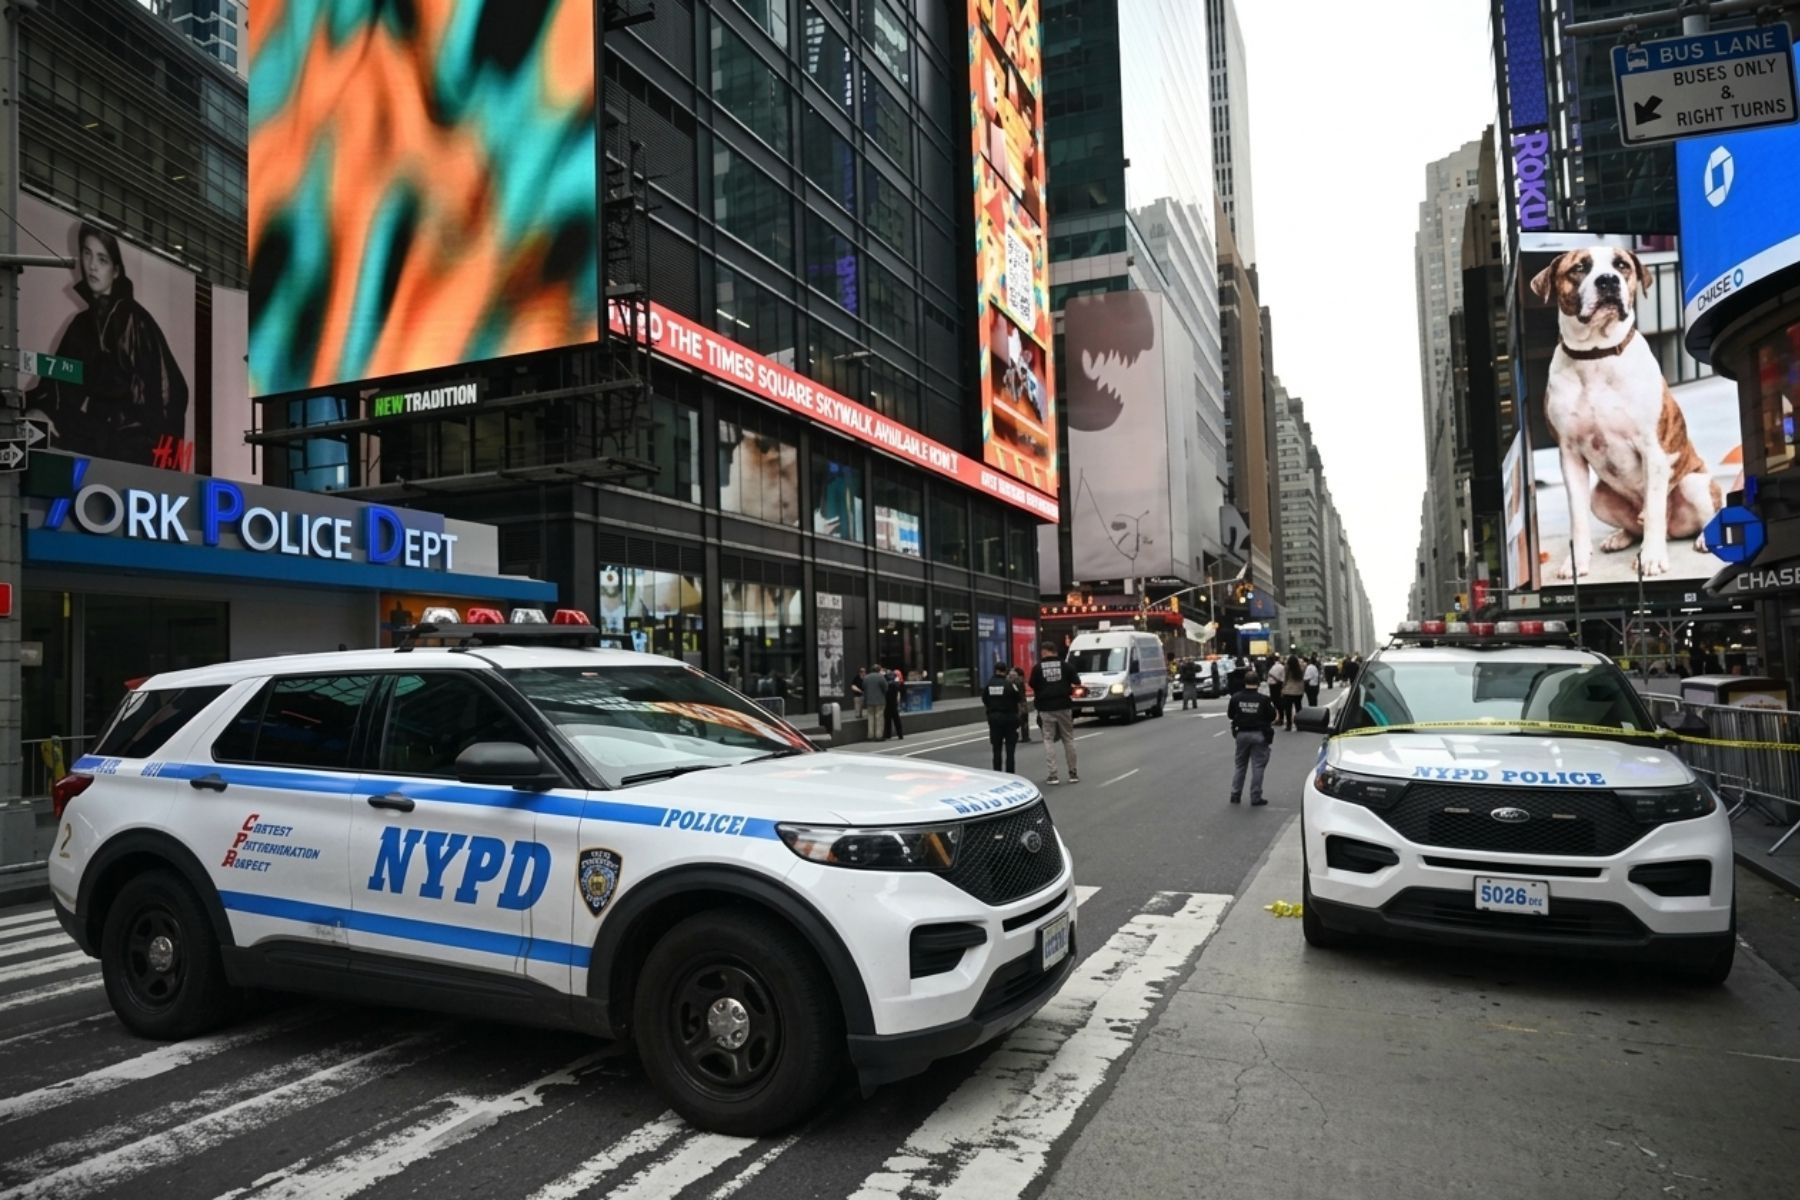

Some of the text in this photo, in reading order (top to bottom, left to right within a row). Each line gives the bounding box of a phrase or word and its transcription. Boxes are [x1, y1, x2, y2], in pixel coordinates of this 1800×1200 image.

[1660, 32, 1775, 63] BUS LANE
[1673, 58, 1777, 86] BUSES ONLY
[1677, 98, 1786, 126] RIGHT TURNS
[1514, 132, 1549, 228] ROKU
[45, 357, 56, 375] 7
[667, 321, 703, 360] THE
[706, 339, 754, 383] TIMES
[758, 364, 813, 411] SQUARE
[816, 392, 873, 437] SKYWALK
[205, 479, 352, 560] POLICE
[367, 505, 458, 570] DEPT
[1413, 766, 1607, 785] NYPD POLICE
[664, 808, 745, 836] POLICE
[368, 826, 552, 911] NYPD
[1481, 885, 1527, 905] 5026
